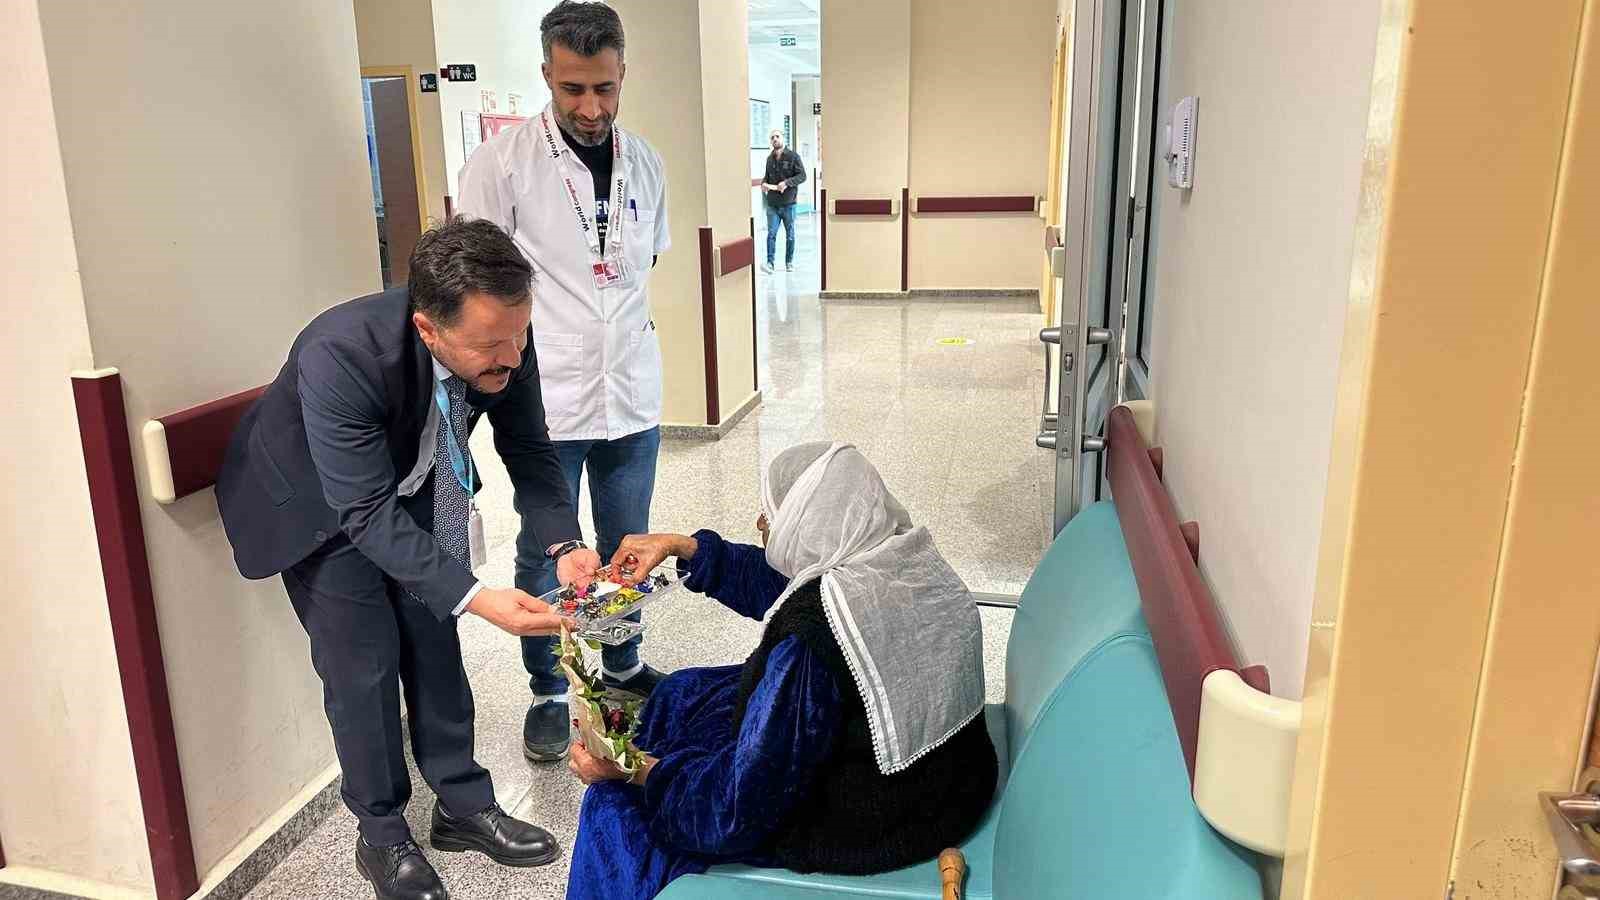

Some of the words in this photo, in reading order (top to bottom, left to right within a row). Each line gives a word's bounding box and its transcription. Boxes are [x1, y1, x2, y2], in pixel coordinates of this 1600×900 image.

[462, 72, 475, 80] WC
[545, 132, 560, 159] World
[615, 178, 624, 203] World
[574, 205, 590, 232] World
